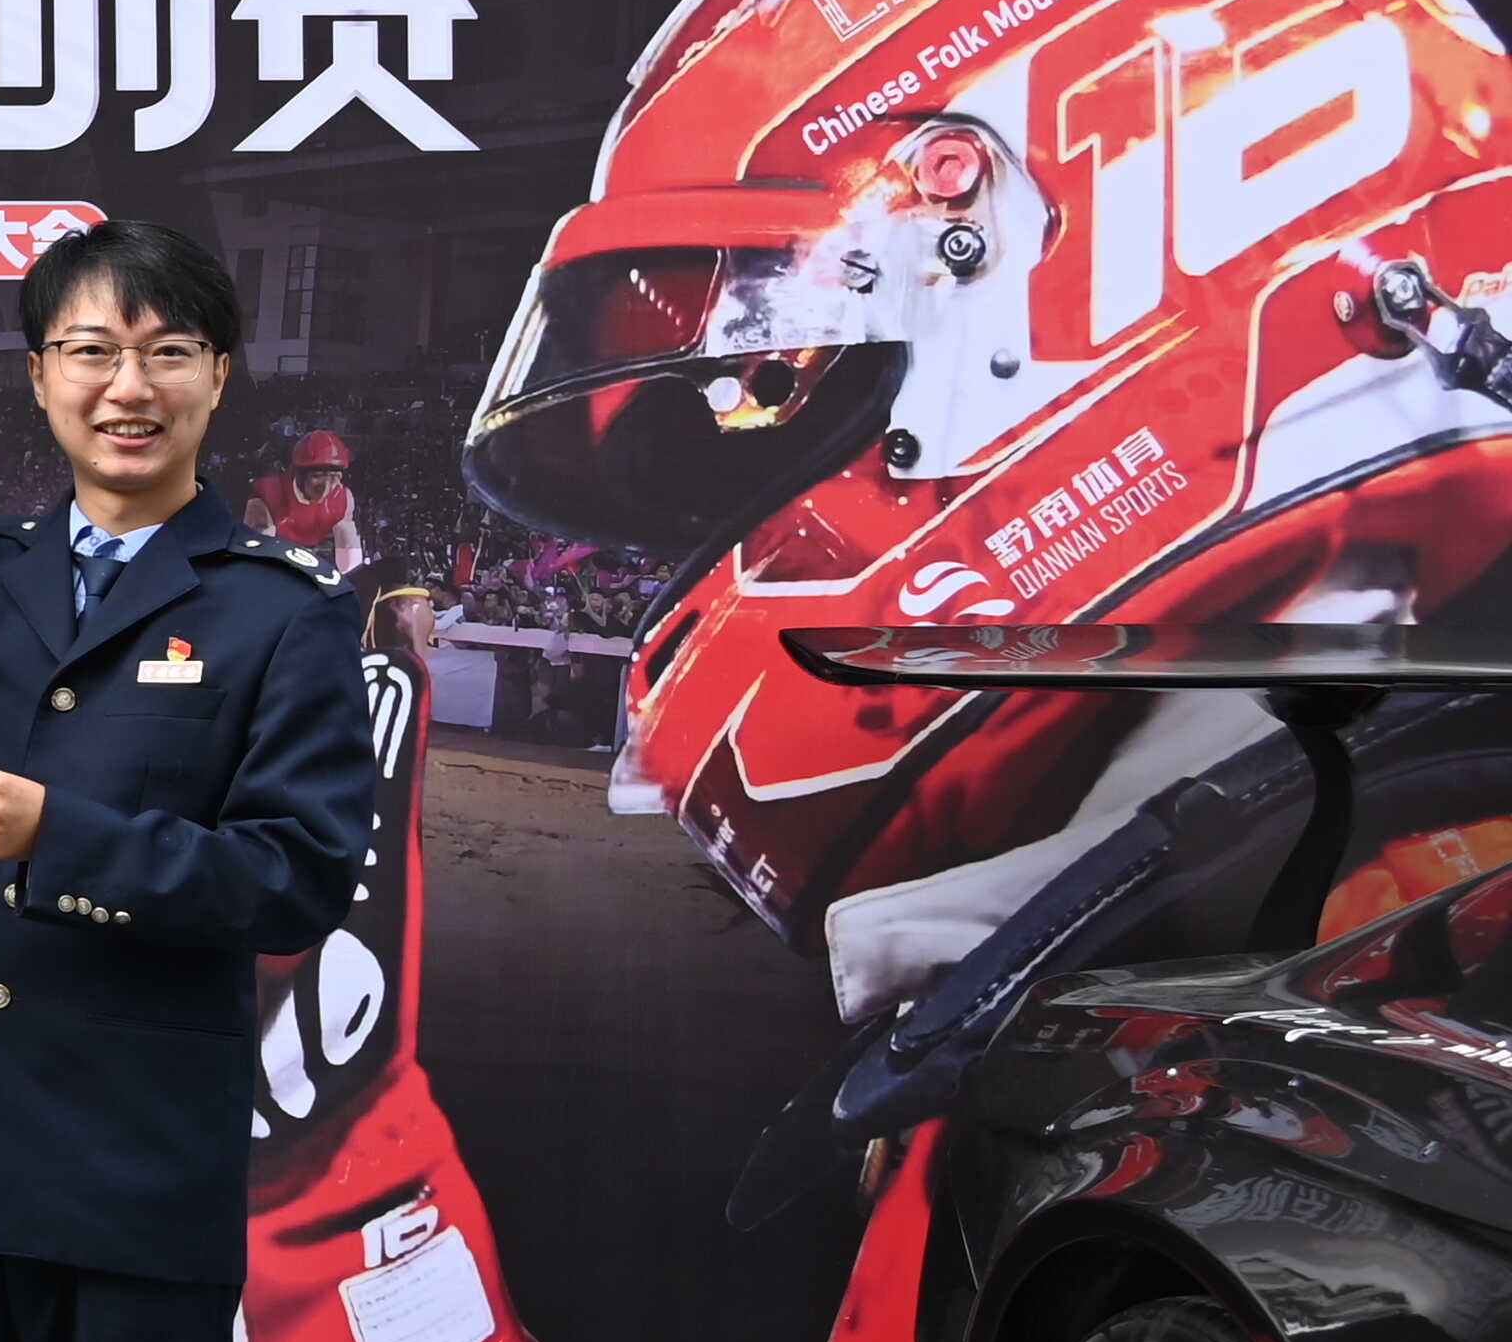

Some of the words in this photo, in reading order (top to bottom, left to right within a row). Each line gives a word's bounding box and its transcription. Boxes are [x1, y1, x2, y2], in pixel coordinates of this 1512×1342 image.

[800, 67, 924, 158] Chinese
[916, 15, 990, 85] Folk
[985, 425, 1168, 567] 黔南体育
[1009, 520, 1108, 600] QIANNAN
[1103, 459, 1190, 533] SPORTS
